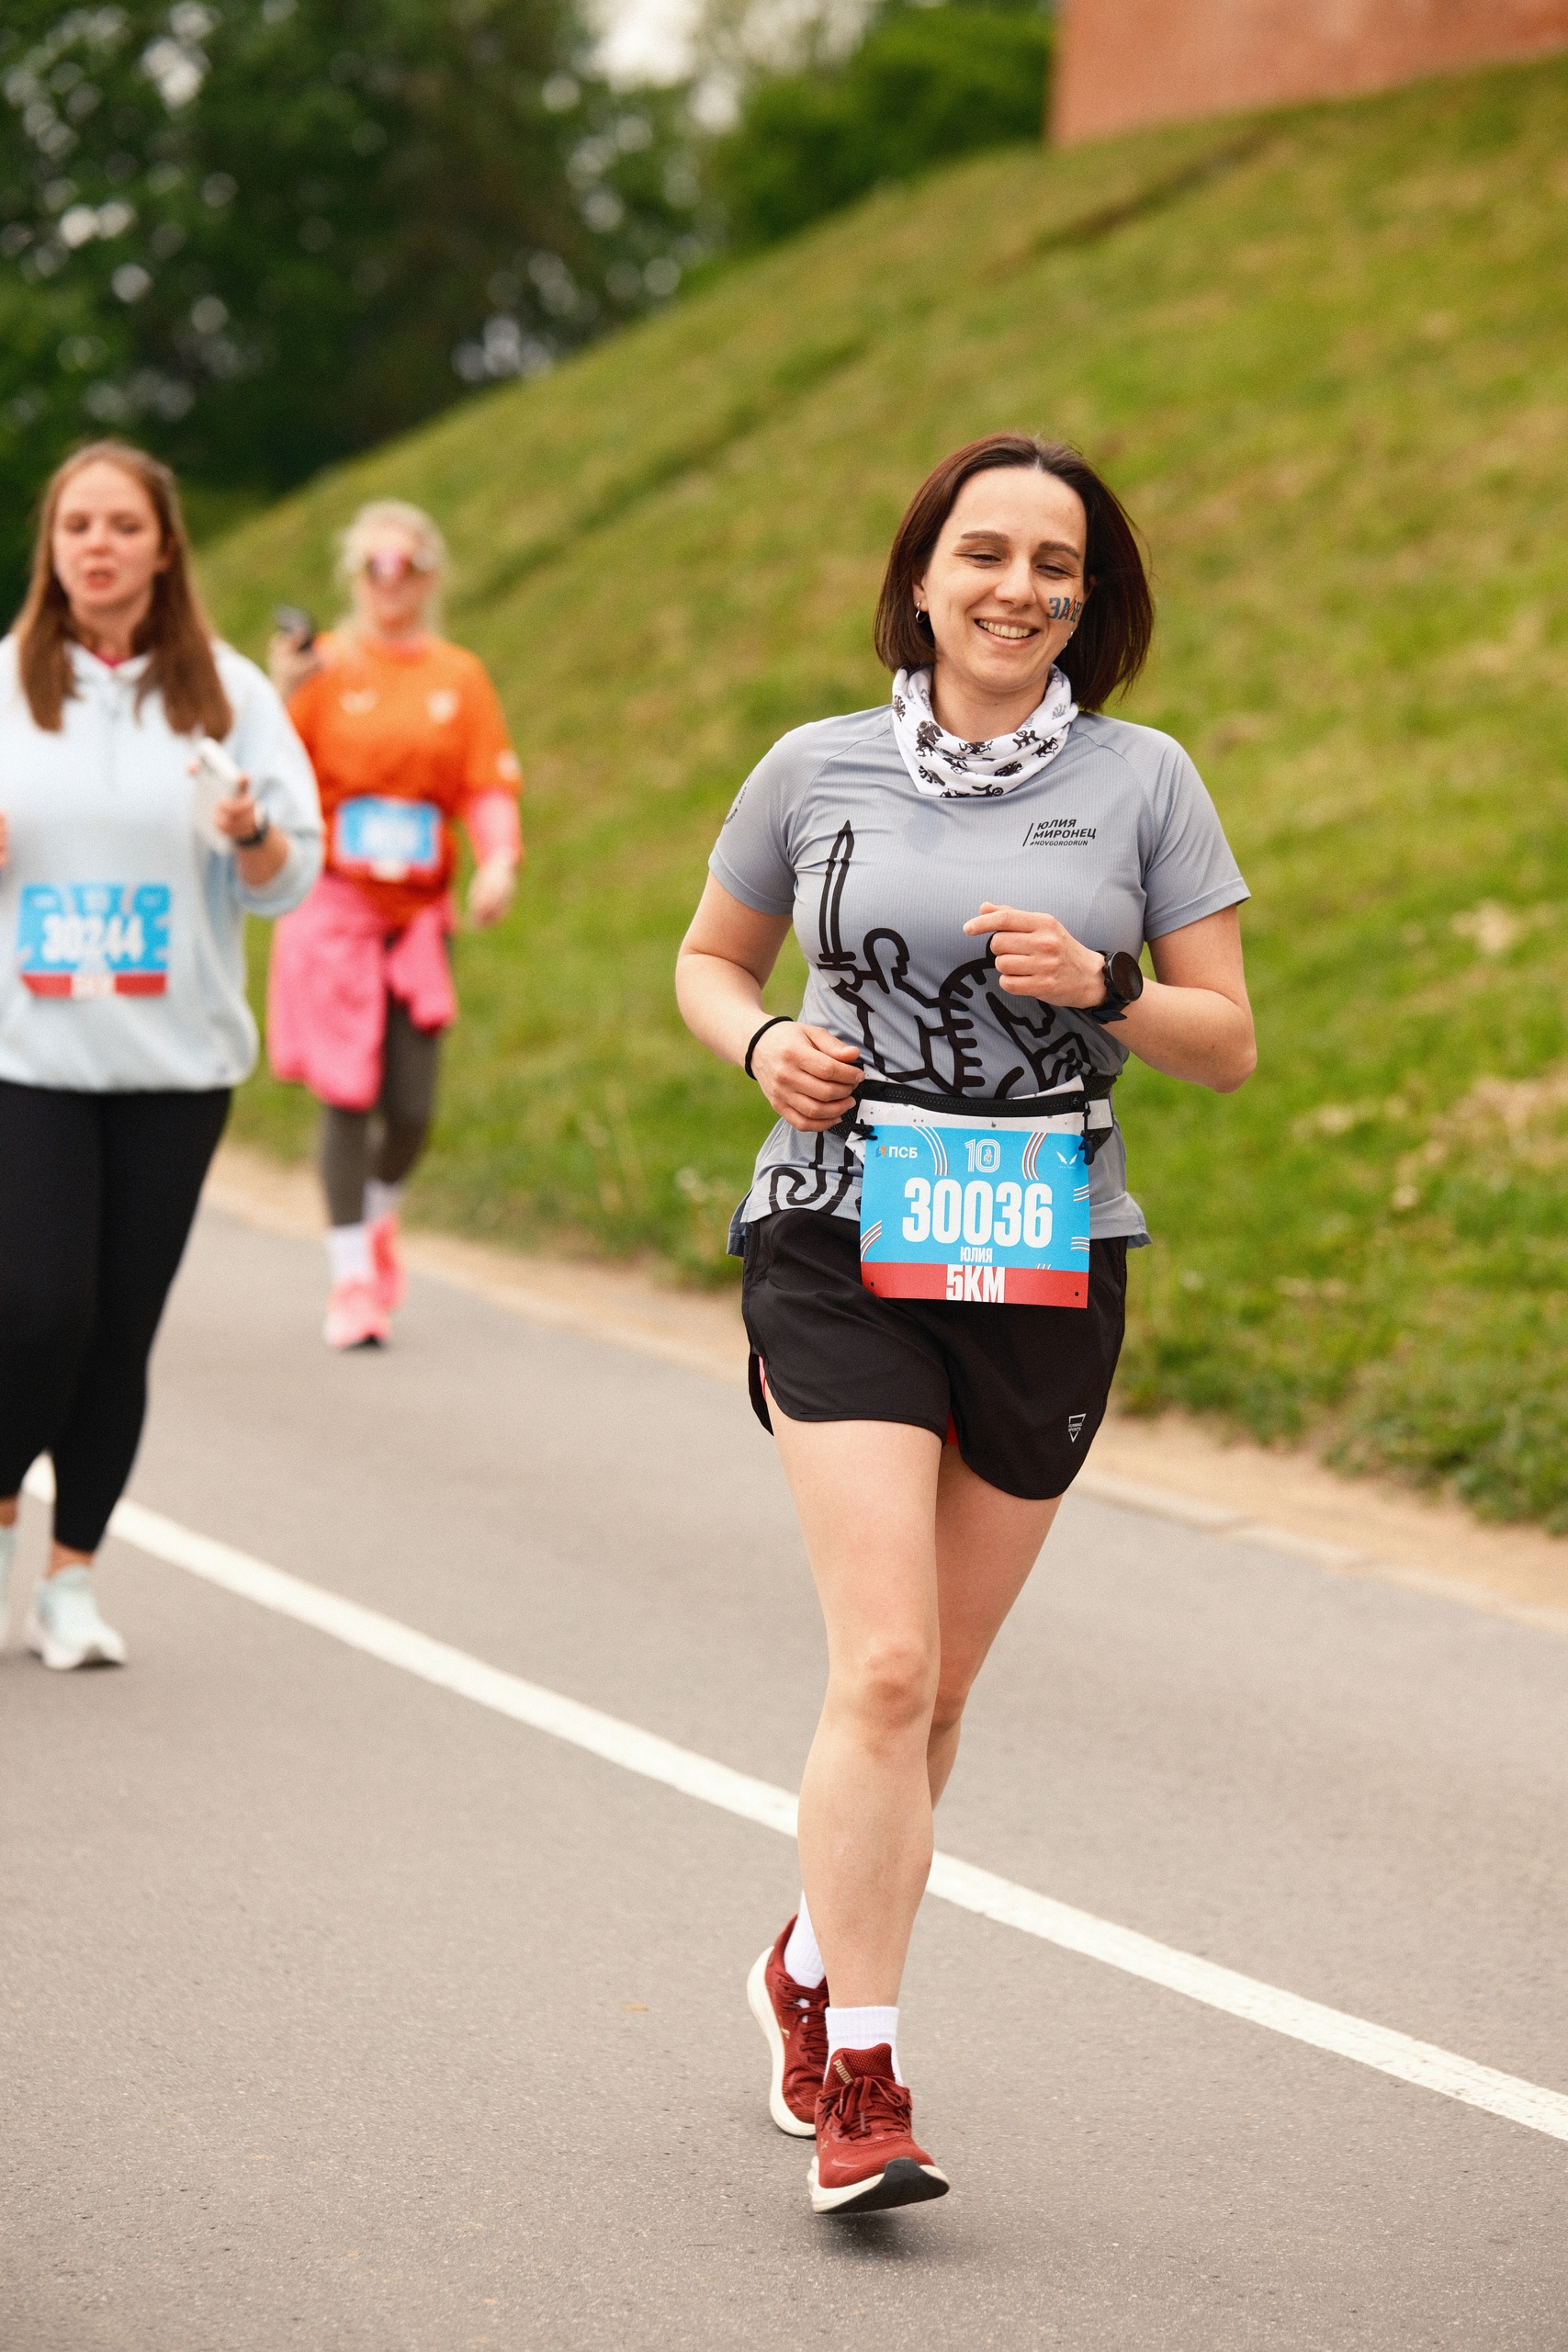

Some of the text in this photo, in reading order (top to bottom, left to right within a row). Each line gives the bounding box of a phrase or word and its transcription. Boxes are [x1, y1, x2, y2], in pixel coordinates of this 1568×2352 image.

[1036, 819, 1077, 831] ЮЛИЯ
[1032, 828, 1097, 840] МИРОНЕЦ
[888, 1146, 918, 1159] ПСБ
[964, 1138, 1001, 1173] 10
[901, 1177, 1053, 1249] 30036
[960, 1246, 993, 1263] ЮЛИЯ
